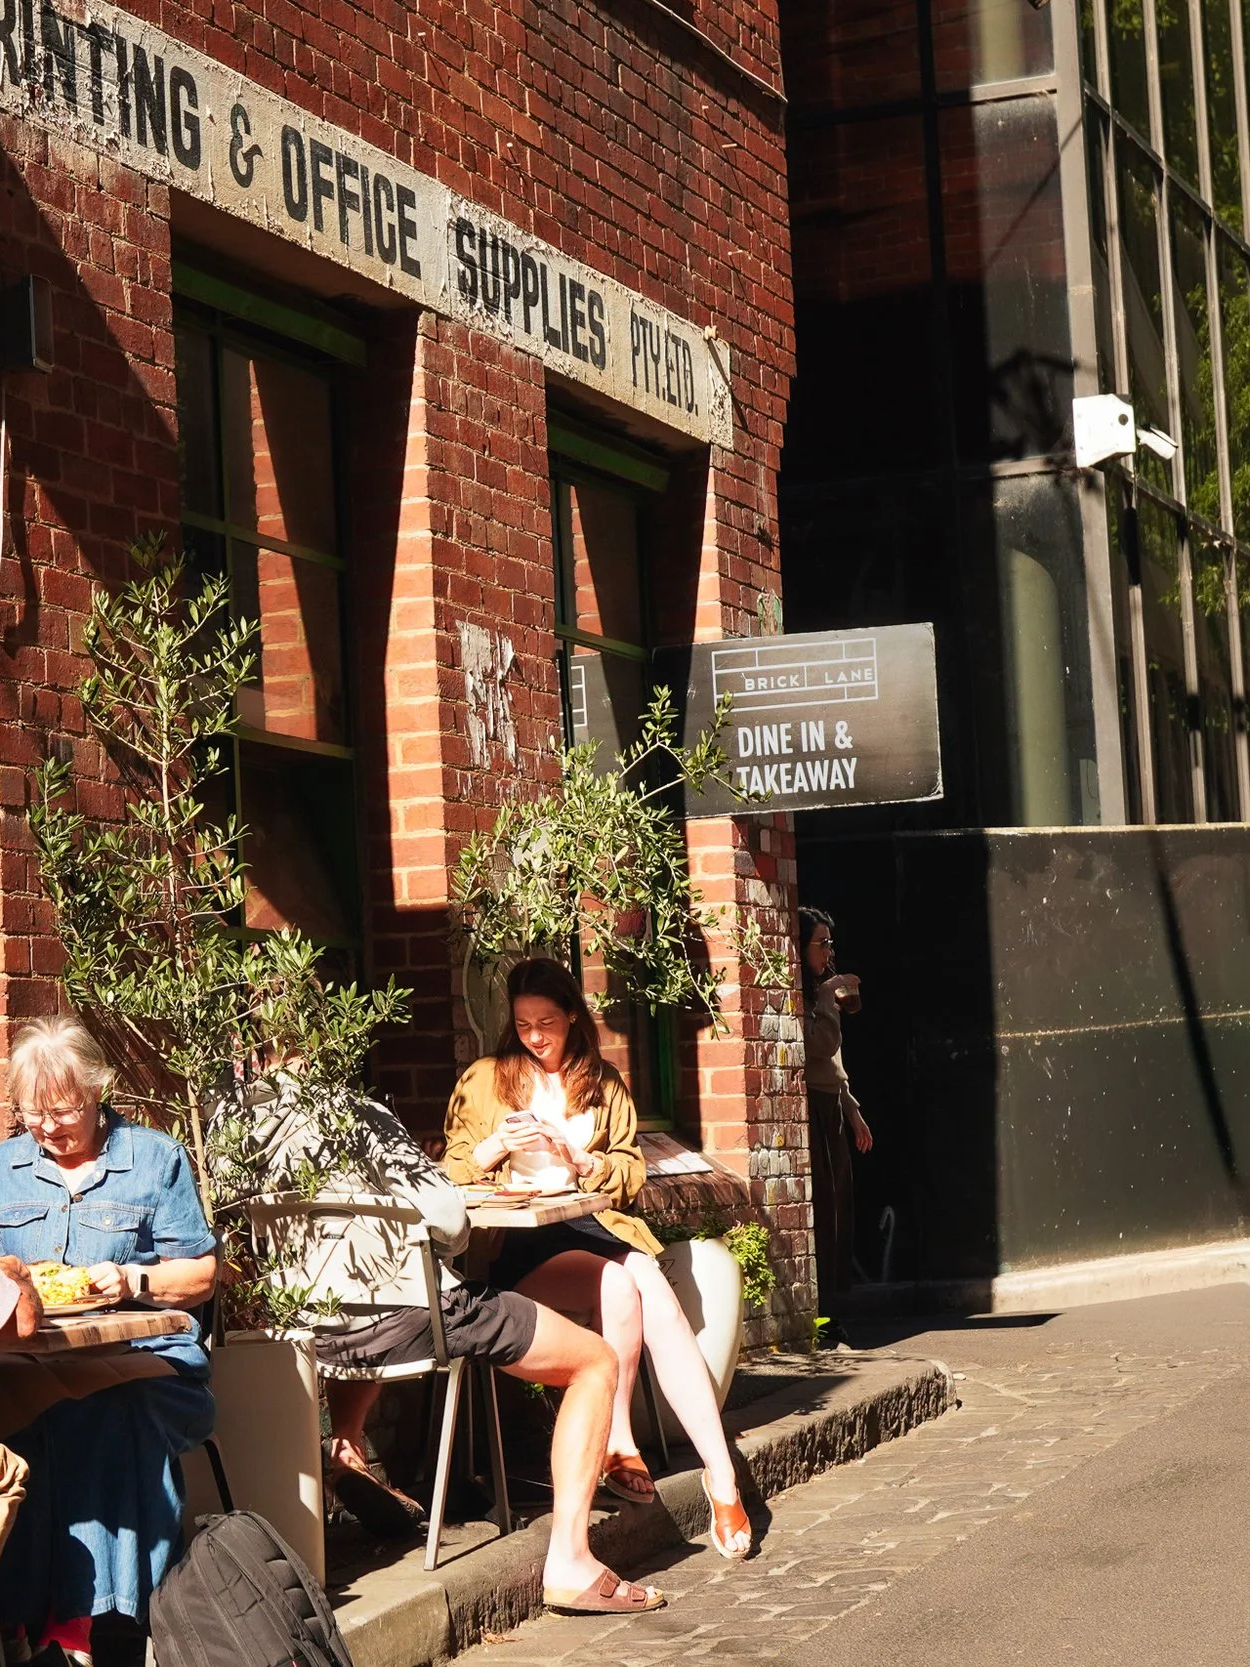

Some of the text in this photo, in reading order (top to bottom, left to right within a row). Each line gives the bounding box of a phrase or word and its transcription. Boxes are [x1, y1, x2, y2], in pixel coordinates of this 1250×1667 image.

[229, 103, 264, 188] &
[281, 124, 422, 280] OFFICE
[454, 217, 607, 371] SUPPLIES
[744, 668, 873, 692] BRICK LANE
[737, 720, 853, 758] DINE IN &
[736, 757, 858, 796] TAKEAWAY
